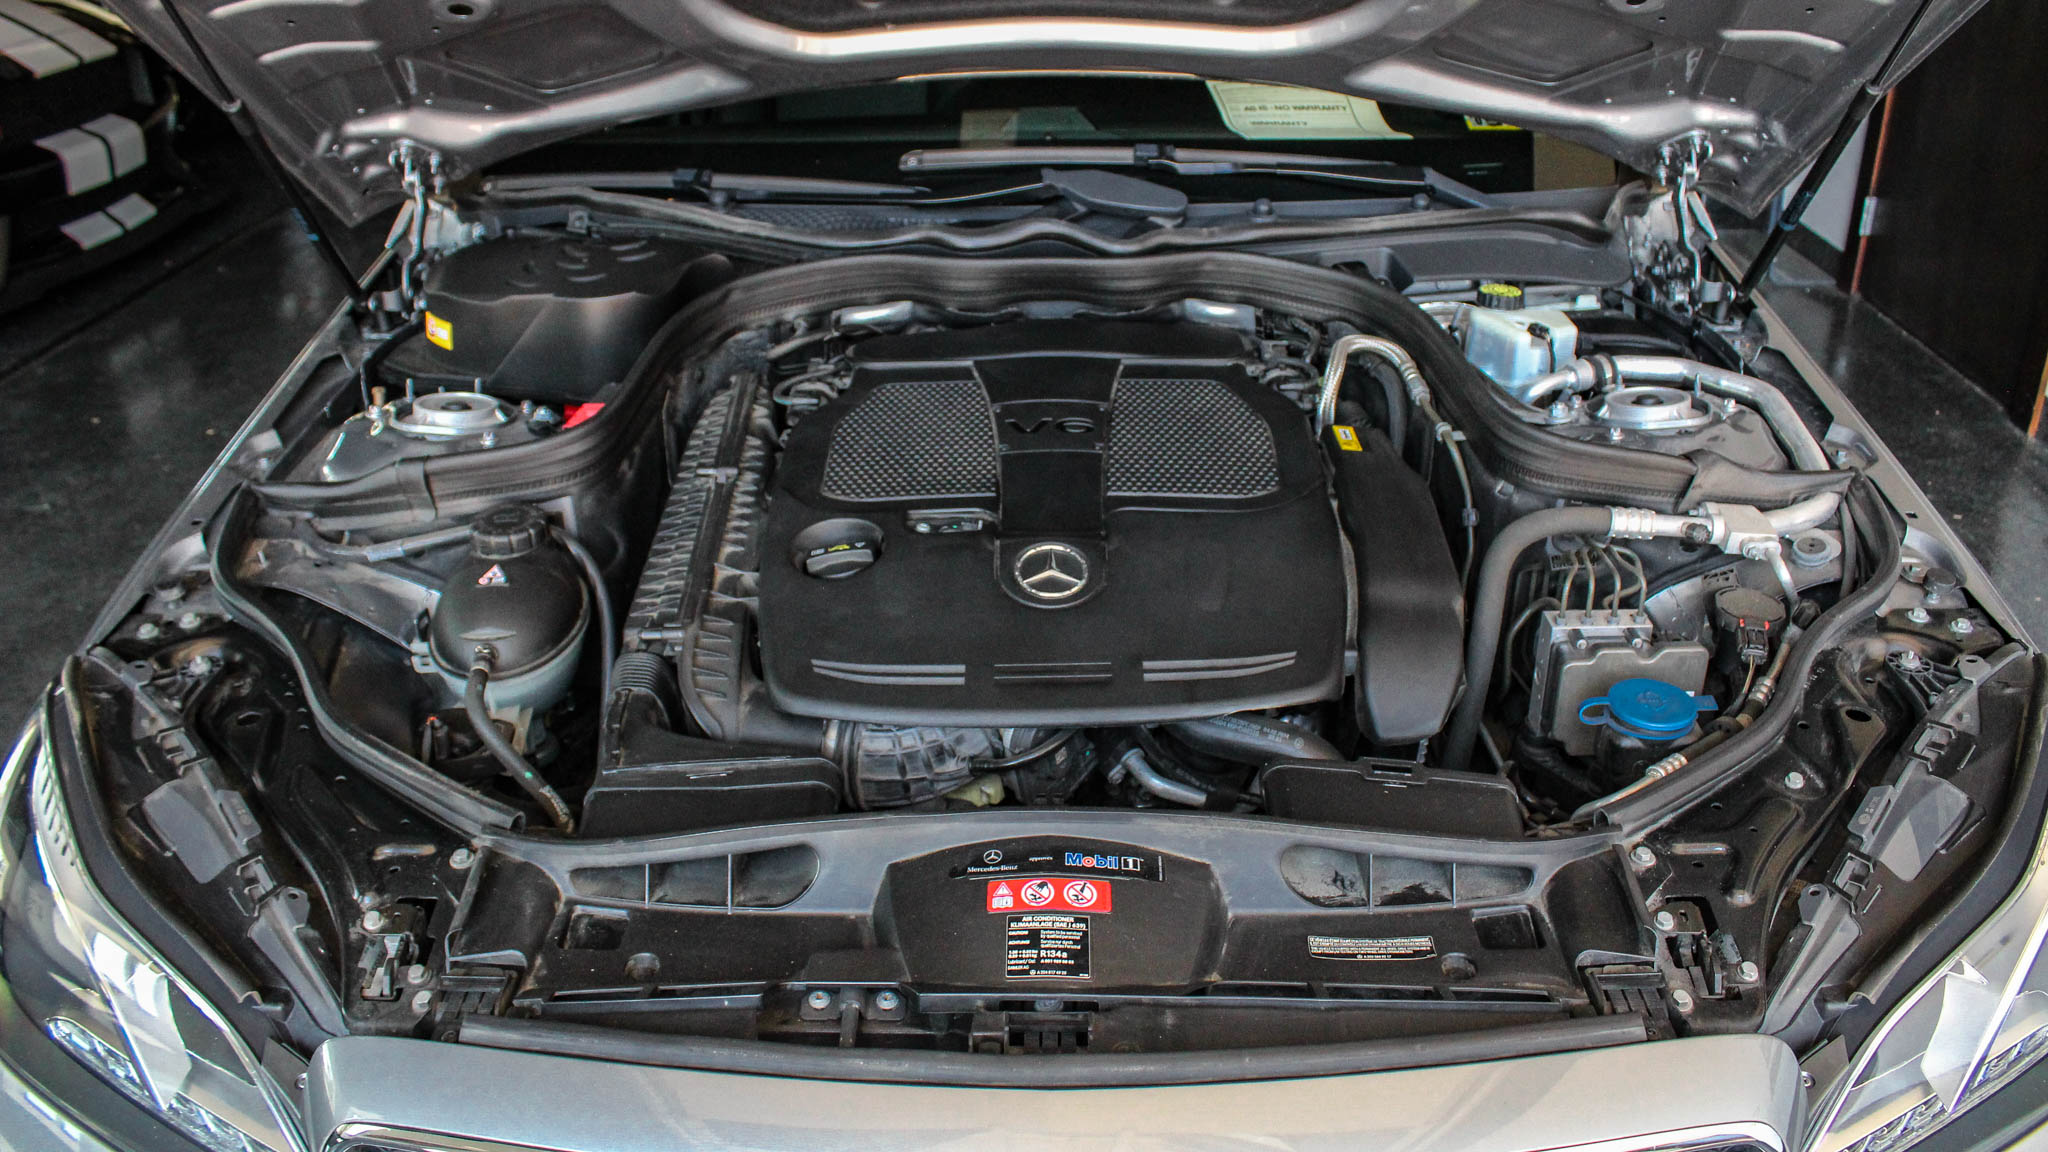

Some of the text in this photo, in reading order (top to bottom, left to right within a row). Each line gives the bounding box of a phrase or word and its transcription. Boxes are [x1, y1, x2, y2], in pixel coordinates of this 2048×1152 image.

[1004, 417, 1095, 433] V6
[1064, 852, 1119, 869] Mobil
[967, 864, 1018, 873] Mercedes-Benz
[1040, 950, 1068, 958] R134a
